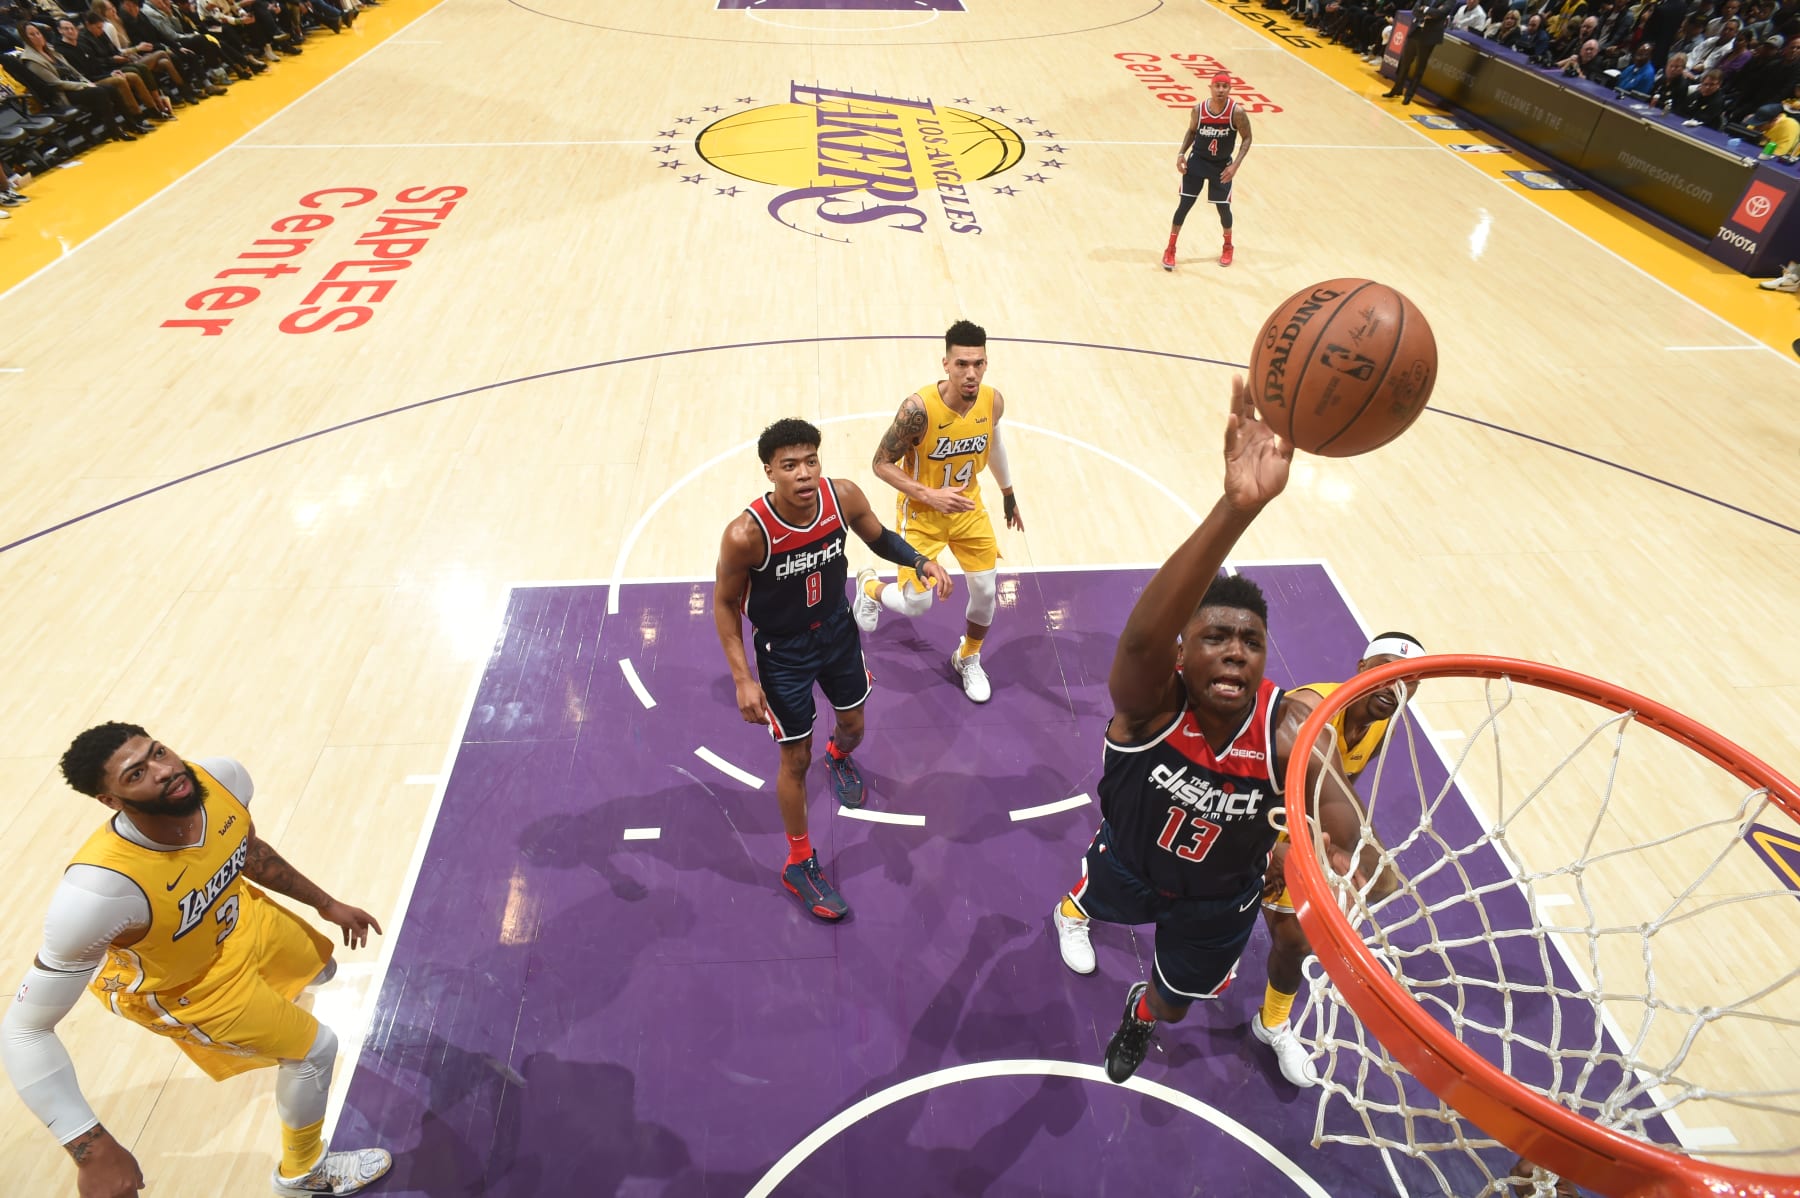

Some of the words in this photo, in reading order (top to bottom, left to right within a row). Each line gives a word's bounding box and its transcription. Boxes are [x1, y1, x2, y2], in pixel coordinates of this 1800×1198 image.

[1230, 6, 1323, 49] LEXUS
[1494, 88, 1532, 116] WELCOME
[1532, 105, 1544, 122] TO
[1545, 112, 1562, 131] THE
[916, 118, 948, 146] LOS
[1208, 138, 1218, 156] 4
[768, 80, 936, 243] LAKERS
[1617, 150, 1714, 205] mgmresorts.com
[926, 147, 982, 236] ANGELES
[159, 187, 378, 337] Center
[278, 185, 468, 336] STAPLES
[1717, 226, 1757, 255] TOYOTA
[1263, 288, 1342, 409] SPALDING
[928, 432, 988, 461] LAKERS
[940, 459, 975, 488] 14
[820, 514, 837, 526] GEICO
[775, 537, 842, 577] district
[806, 571, 821, 607] 8
[1230, 748, 1265, 761] GEICO
[1151, 764, 1264, 815] district
[1190, 776, 1210, 790] THE
[217, 814, 237, 836] wish
[1156, 805, 1222, 863] 13
[172, 835, 248, 942] LAKERS
[215, 894, 240, 946] 3
